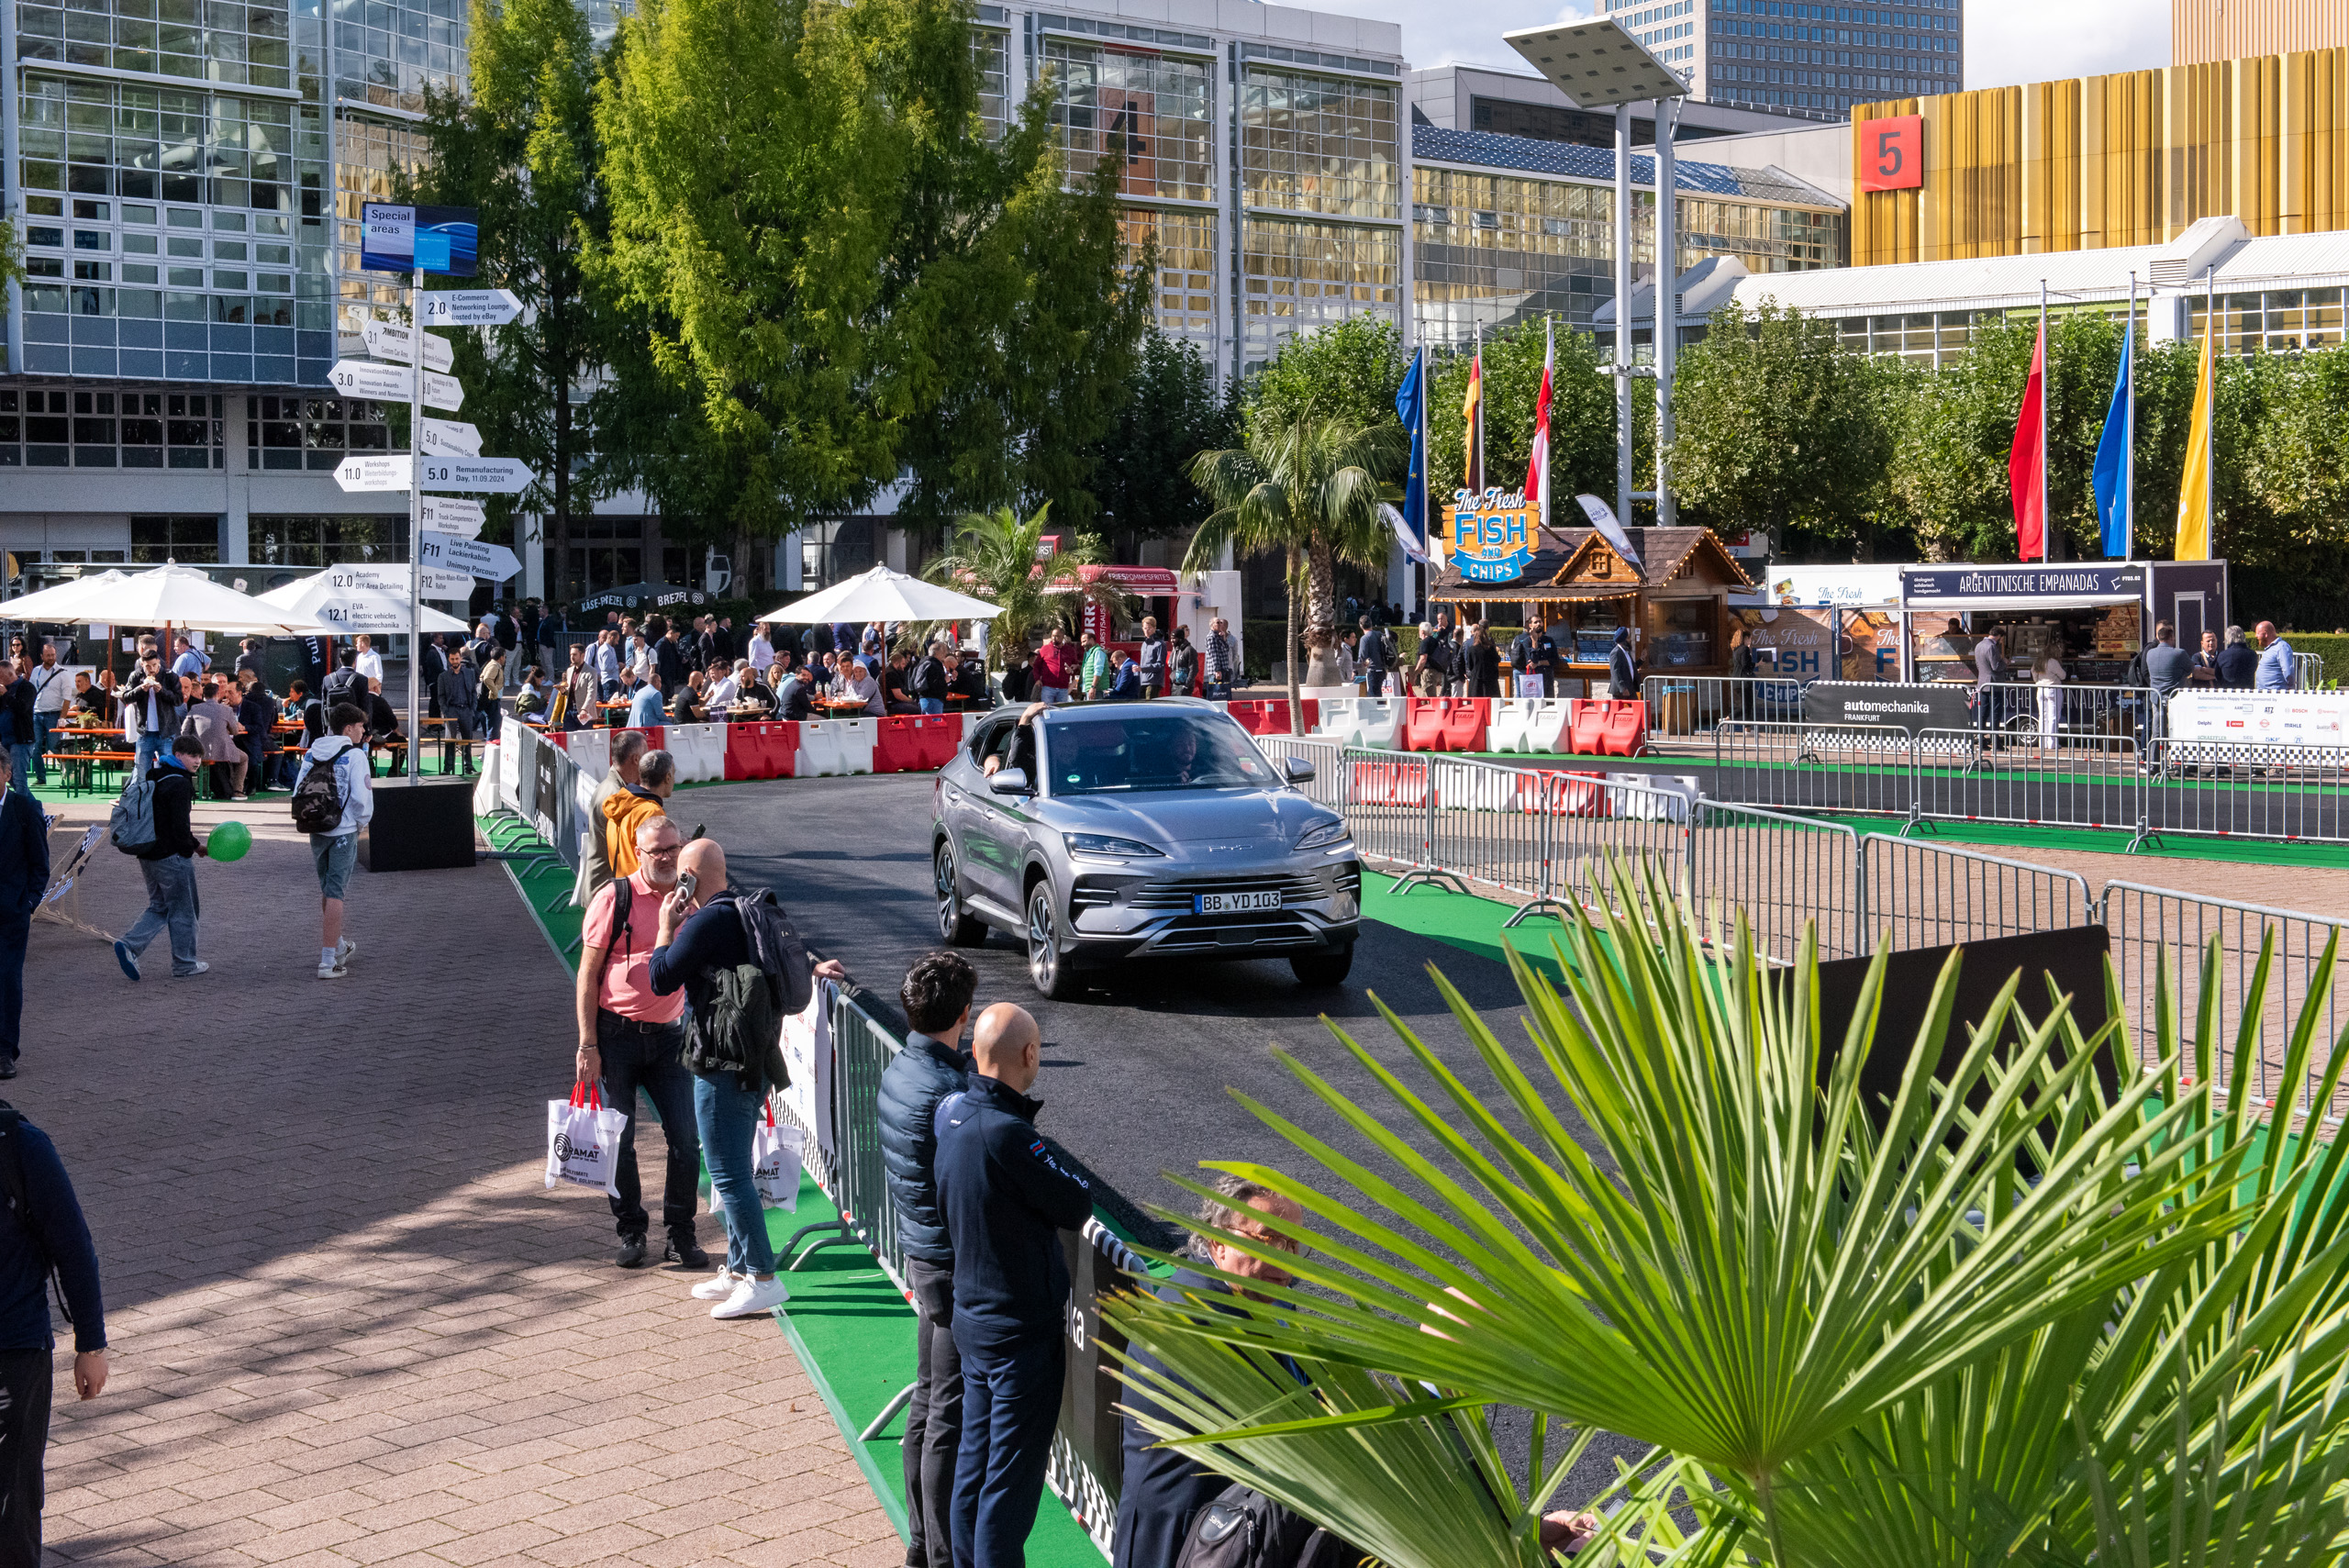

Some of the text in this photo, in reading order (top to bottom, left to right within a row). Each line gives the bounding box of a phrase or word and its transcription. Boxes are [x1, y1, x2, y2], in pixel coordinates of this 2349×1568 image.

[1106, 101, 1147, 164] 4
[1878, 131, 1903, 176] 5
[372, 209, 410, 221] Special
[371, 225, 400, 234] areas
[428, 302, 446, 315] 2.0
[473, 313, 481, 321] by
[482, 313, 497, 321] eBay
[368, 330, 377, 345] 3.1
[381, 346, 394, 355] Custom
[338, 373, 353, 386] 3.0
[359, 378, 383, 387] Innovation
[383, 381, 399, 389] Awards
[359, 387, 378, 395] Winners
[387, 390, 409, 399] Nominees
[426, 429, 438, 446] 5.0
[440, 438, 464, 456] Sustainability
[364, 461, 390, 469] Workshops
[455, 465, 514, 475] Remanufacturing
[345, 467, 361, 480] 11.0
[428, 467, 448, 480] 5.0
[455, 474, 471, 483] Day,
[1453, 485, 1526, 512] The Fresh
[422, 506, 434, 520] F11
[439, 501, 479, 512] Caravan Competence
[450, 514, 473, 523] Competence
[438, 522, 460, 530] Workshops
[1454, 511, 1528, 547] FISH
[422, 542, 440, 558] F11
[450, 539, 490, 554] Live Painting
[1481, 546, 1502, 559] AND
[448, 548, 491, 563] Lackierkabine
[355, 571, 380, 579] Academy
[446, 560, 499, 577] Unimog Parcours
[1469, 562, 1513, 580] CHIPS
[332, 574, 353, 587] 12.0
[379, 583, 404, 591] Detailing
[421, 575, 433, 588] F12
[1959, 573, 2099, 593] ARGENTINISCHE EMPANADAS
[657, 591, 688, 606] BREZEL
[1818, 586, 1862, 599] The Fresh
[328, 608, 348, 621] 12.1
[1752, 628, 1819, 646] The Fresh
[1843, 700, 1930, 714] automechanika
[1843, 713, 1881, 722] FRANKFURT
[1203, 892, 1280, 911] BB YD 103
[557, 1144, 600, 1160] PARAMAT
